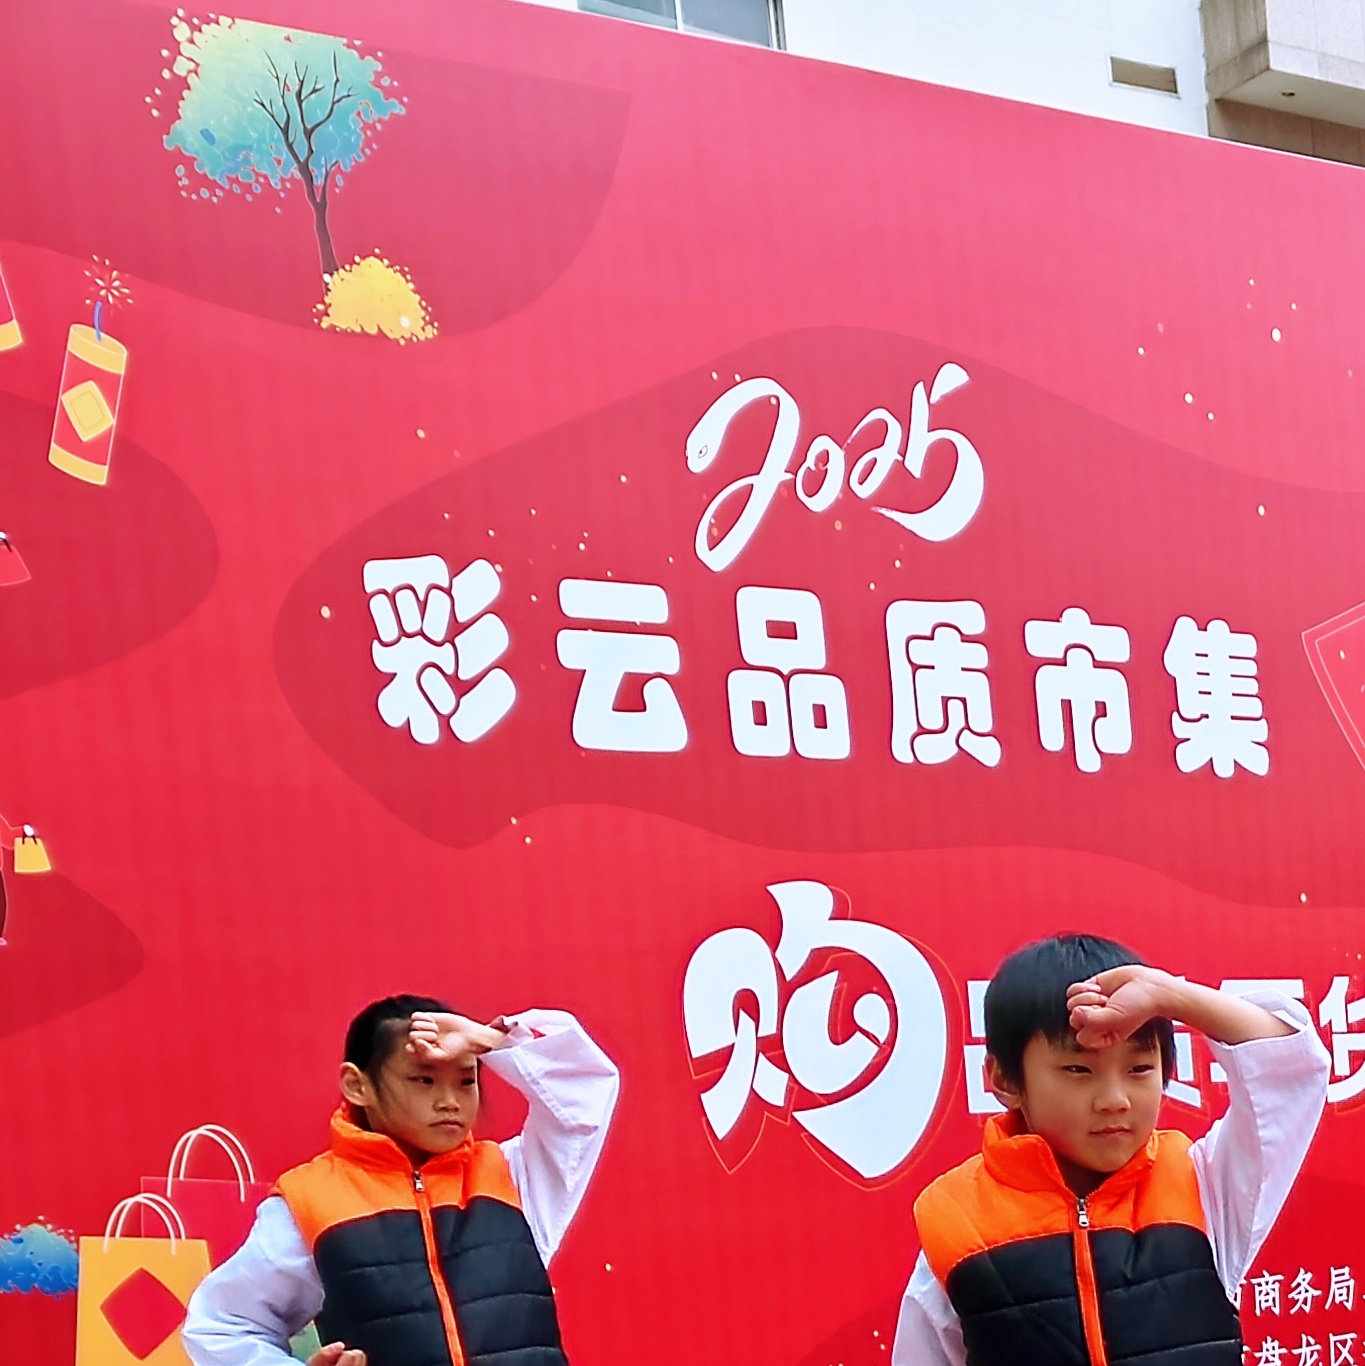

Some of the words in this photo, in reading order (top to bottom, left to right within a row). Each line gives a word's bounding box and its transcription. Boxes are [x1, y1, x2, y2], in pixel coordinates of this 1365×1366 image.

[686, 361, 985, 571] 2025
[362, 554, 1270, 779] 彩云品质市集
[683, 879, 948, 1179] 购
